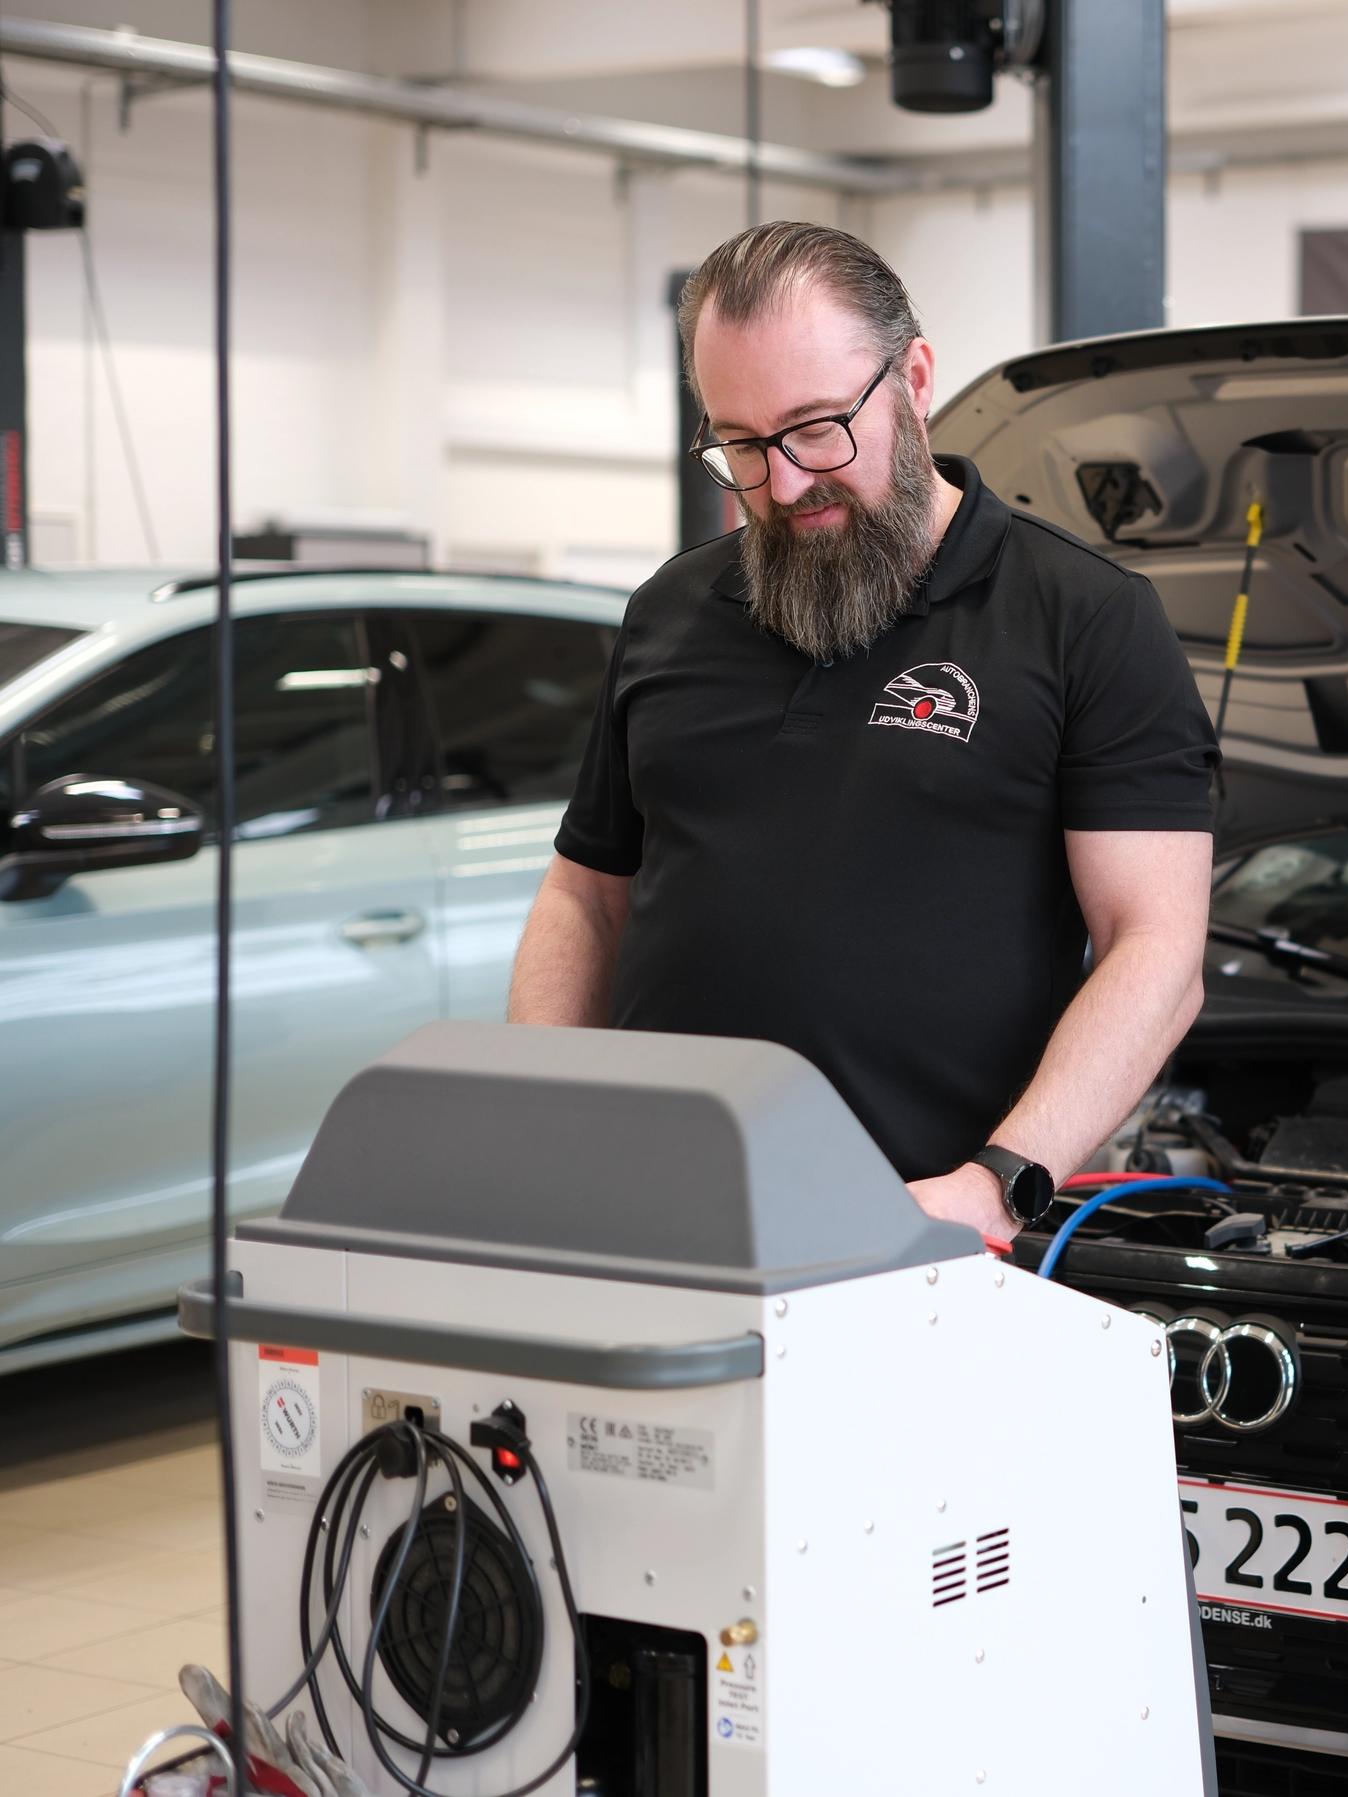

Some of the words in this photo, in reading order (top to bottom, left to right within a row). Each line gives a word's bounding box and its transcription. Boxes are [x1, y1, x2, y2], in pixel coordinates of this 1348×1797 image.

[940, 665, 976, 716] AUTOBRANCHENS
[878, 715, 961, 736] UDVIKLINGSCENTER
[1198, 1606, 1272, 1629] DENSE.dk
